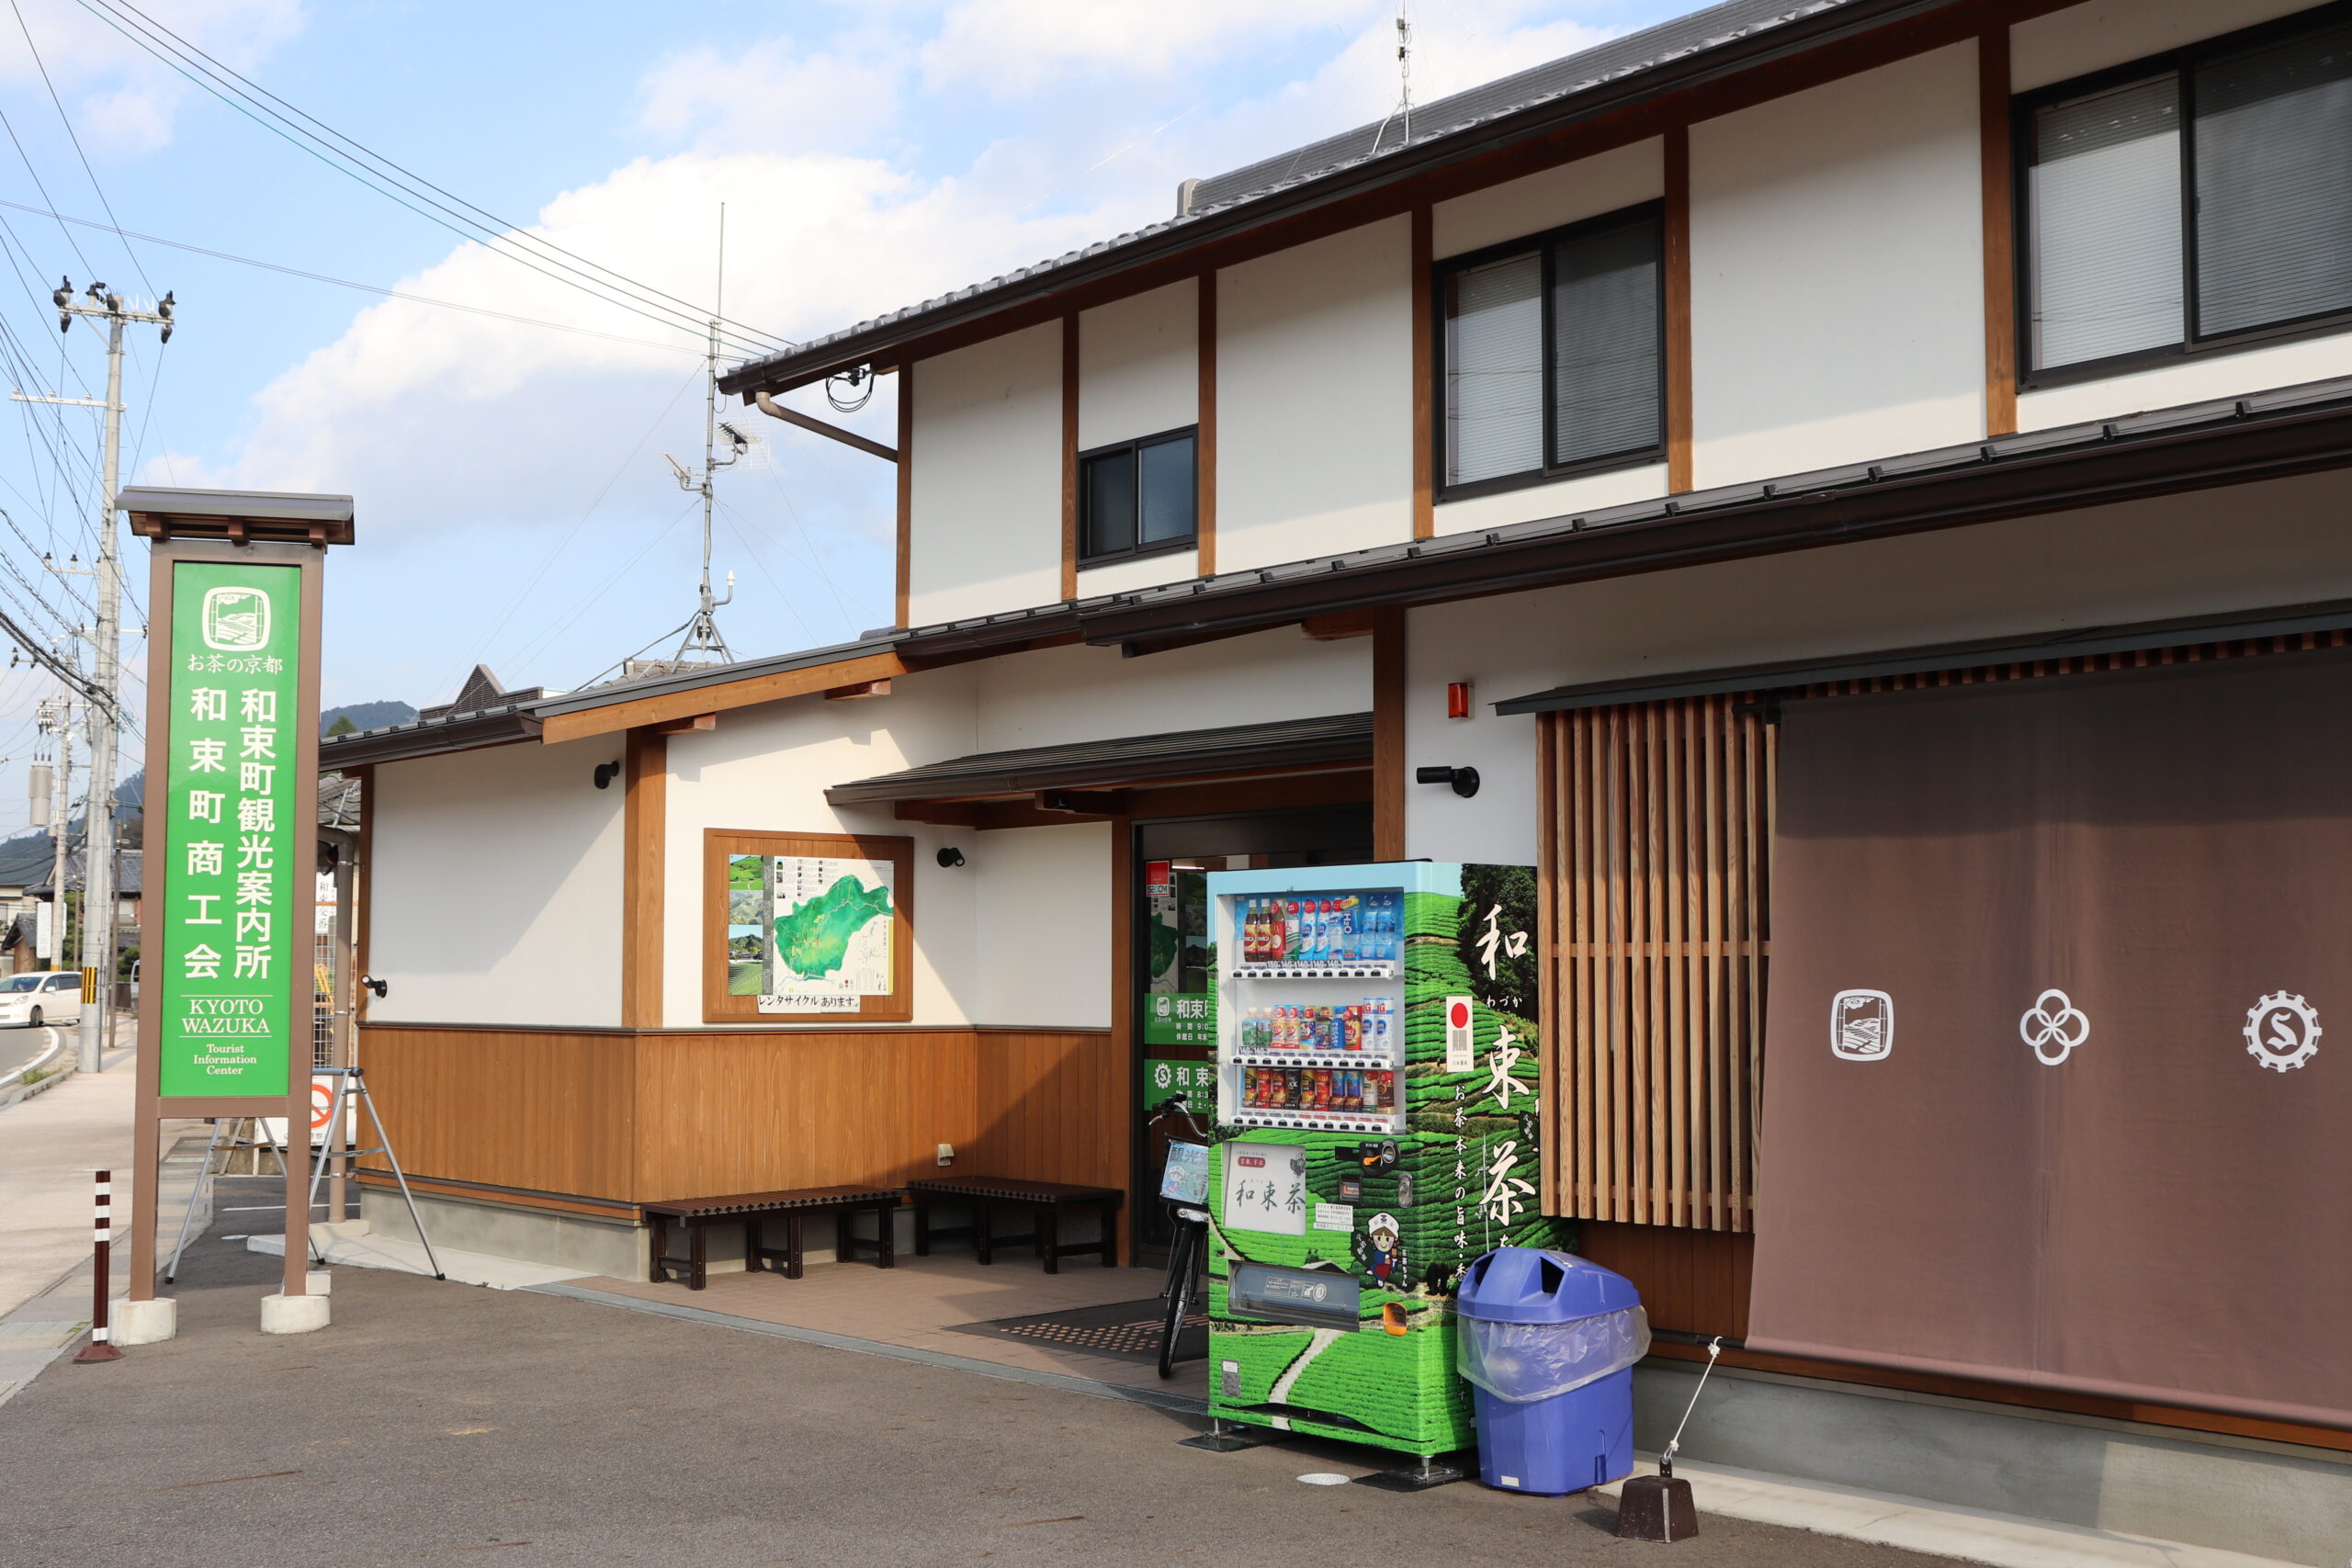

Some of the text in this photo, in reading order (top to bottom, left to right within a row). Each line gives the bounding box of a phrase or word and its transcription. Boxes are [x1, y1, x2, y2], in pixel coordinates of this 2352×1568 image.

[187, 653, 283, 675] お茶の京都
[184, 686, 227, 979] 和束町商工会
[233, 688, 277, 979] 和束町観光案内所
[189, 998, 264, 1015] KYOTO
[758, 996, 858, 1007] レンタサイクル あります。
[1177, 999, 1208, 1019] 和束
[1487, 995, 1522, 1009] わづか
[182, 1018, 271, 1033] WAZUKA
[207, 1043, 244, 1053] Tourist
[193, 1055, 257, 1064] Information
[206, 1066, 243, 1075] Center
